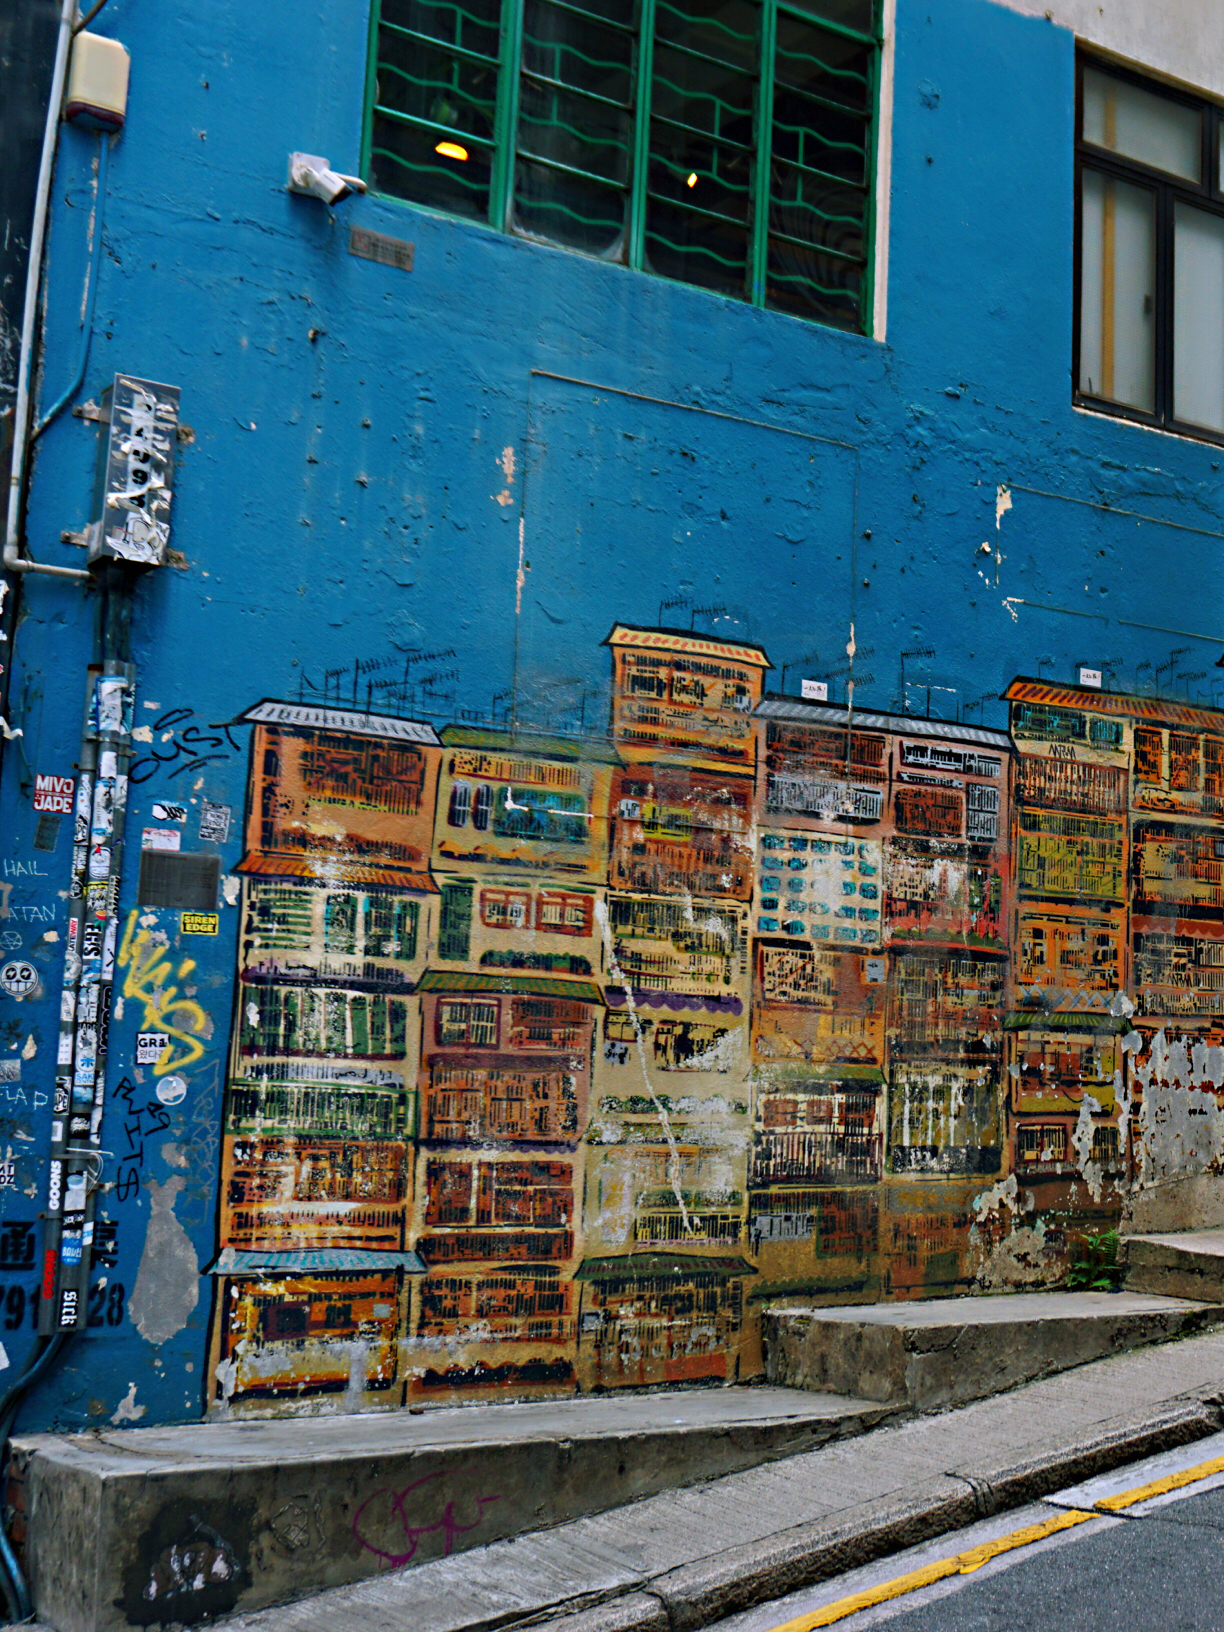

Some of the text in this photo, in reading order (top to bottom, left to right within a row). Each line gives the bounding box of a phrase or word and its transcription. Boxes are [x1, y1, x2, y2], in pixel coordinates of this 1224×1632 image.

[34, 795, 73, 814] JAPE
[3, 859, 49, 877] HAIL
[8, 903, 56, 923] ATAN
[184, 914, 216, 925] SIREN
[185, 923, 214, 932] EDGE
[48, 1160, 62, 1211] GOONS
[43, 1249, 57, 1299] GOONS
